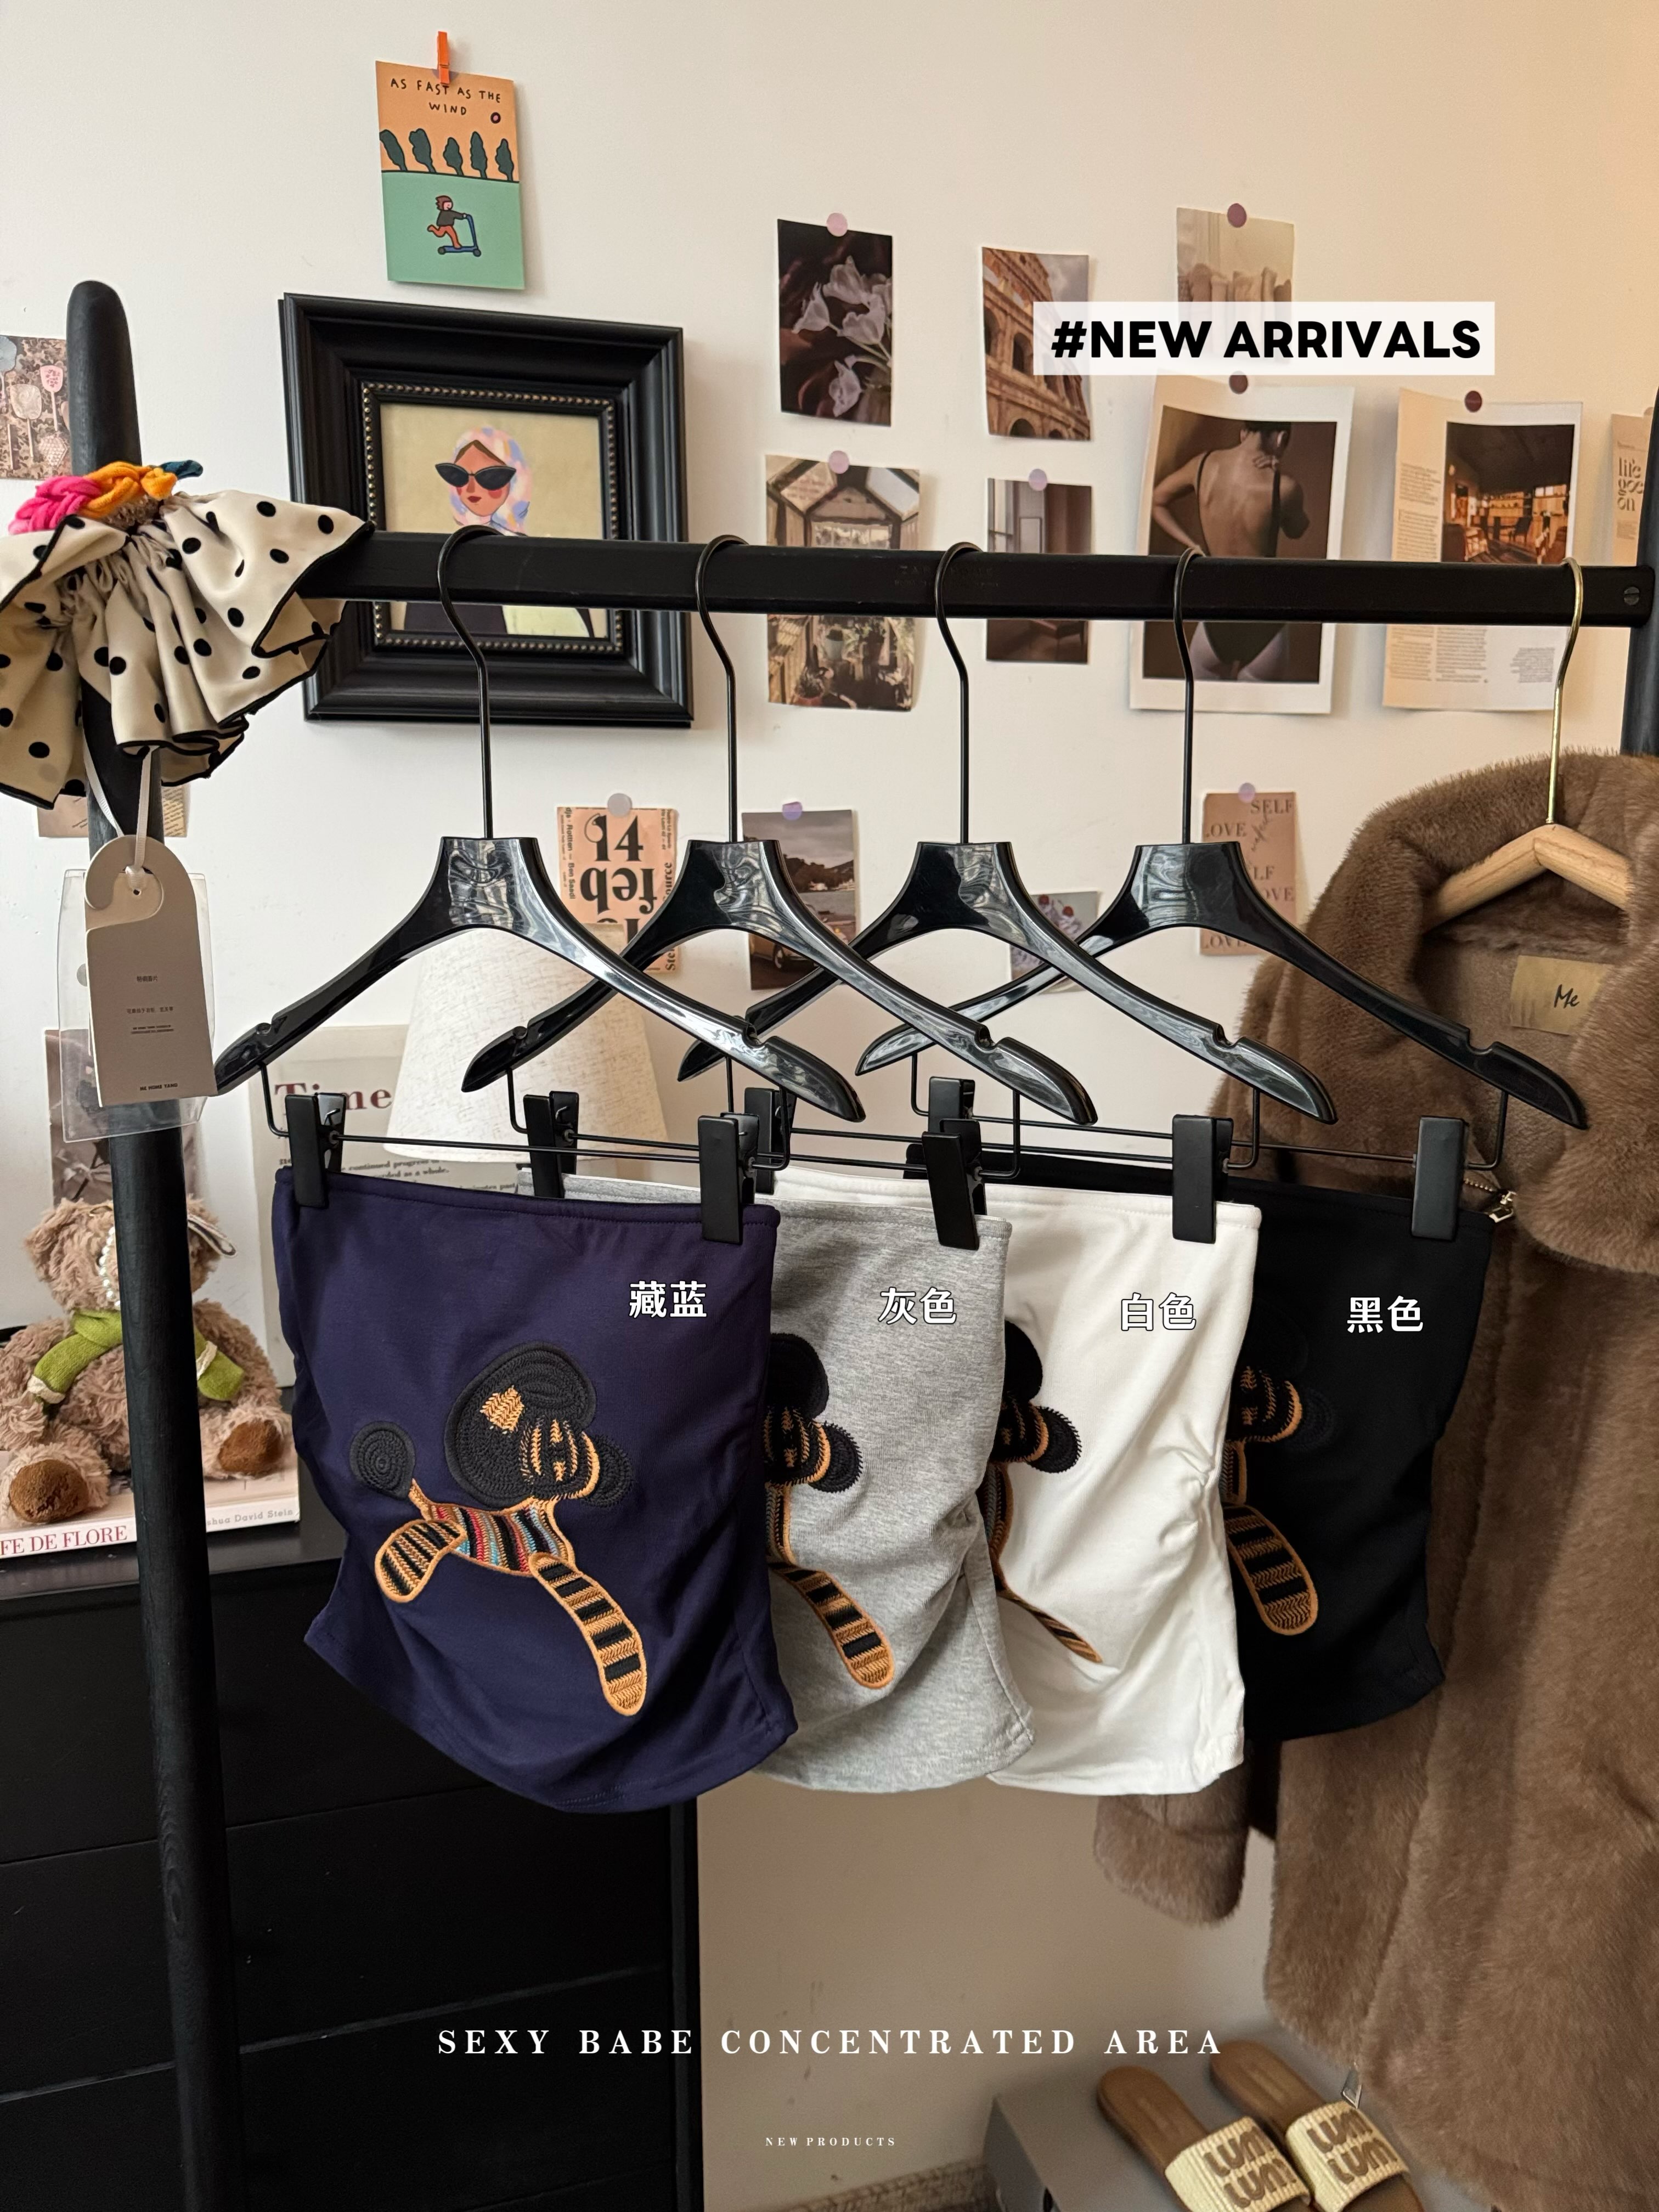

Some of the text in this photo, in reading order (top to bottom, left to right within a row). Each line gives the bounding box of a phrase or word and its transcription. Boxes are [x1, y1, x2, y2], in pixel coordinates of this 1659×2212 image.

[391, 78, 501, 103] AS FAST AS THE
[428, 102, 466, 115] WIND
[1618, 478, 1643, 496] goe
[1250, 799, 1294, 814] SELF
[1204, 822, 1247, 838] OVE
[580, 867, 657, 915] feb
[1554, 984, 1579, 1008] Me
[234, 1511, 263, 1522] David
[267, 1509, 294, 1519] Stein
[30, 1534, 58, 1552] DE
[62, 1525, 128, 1548] FLORE
